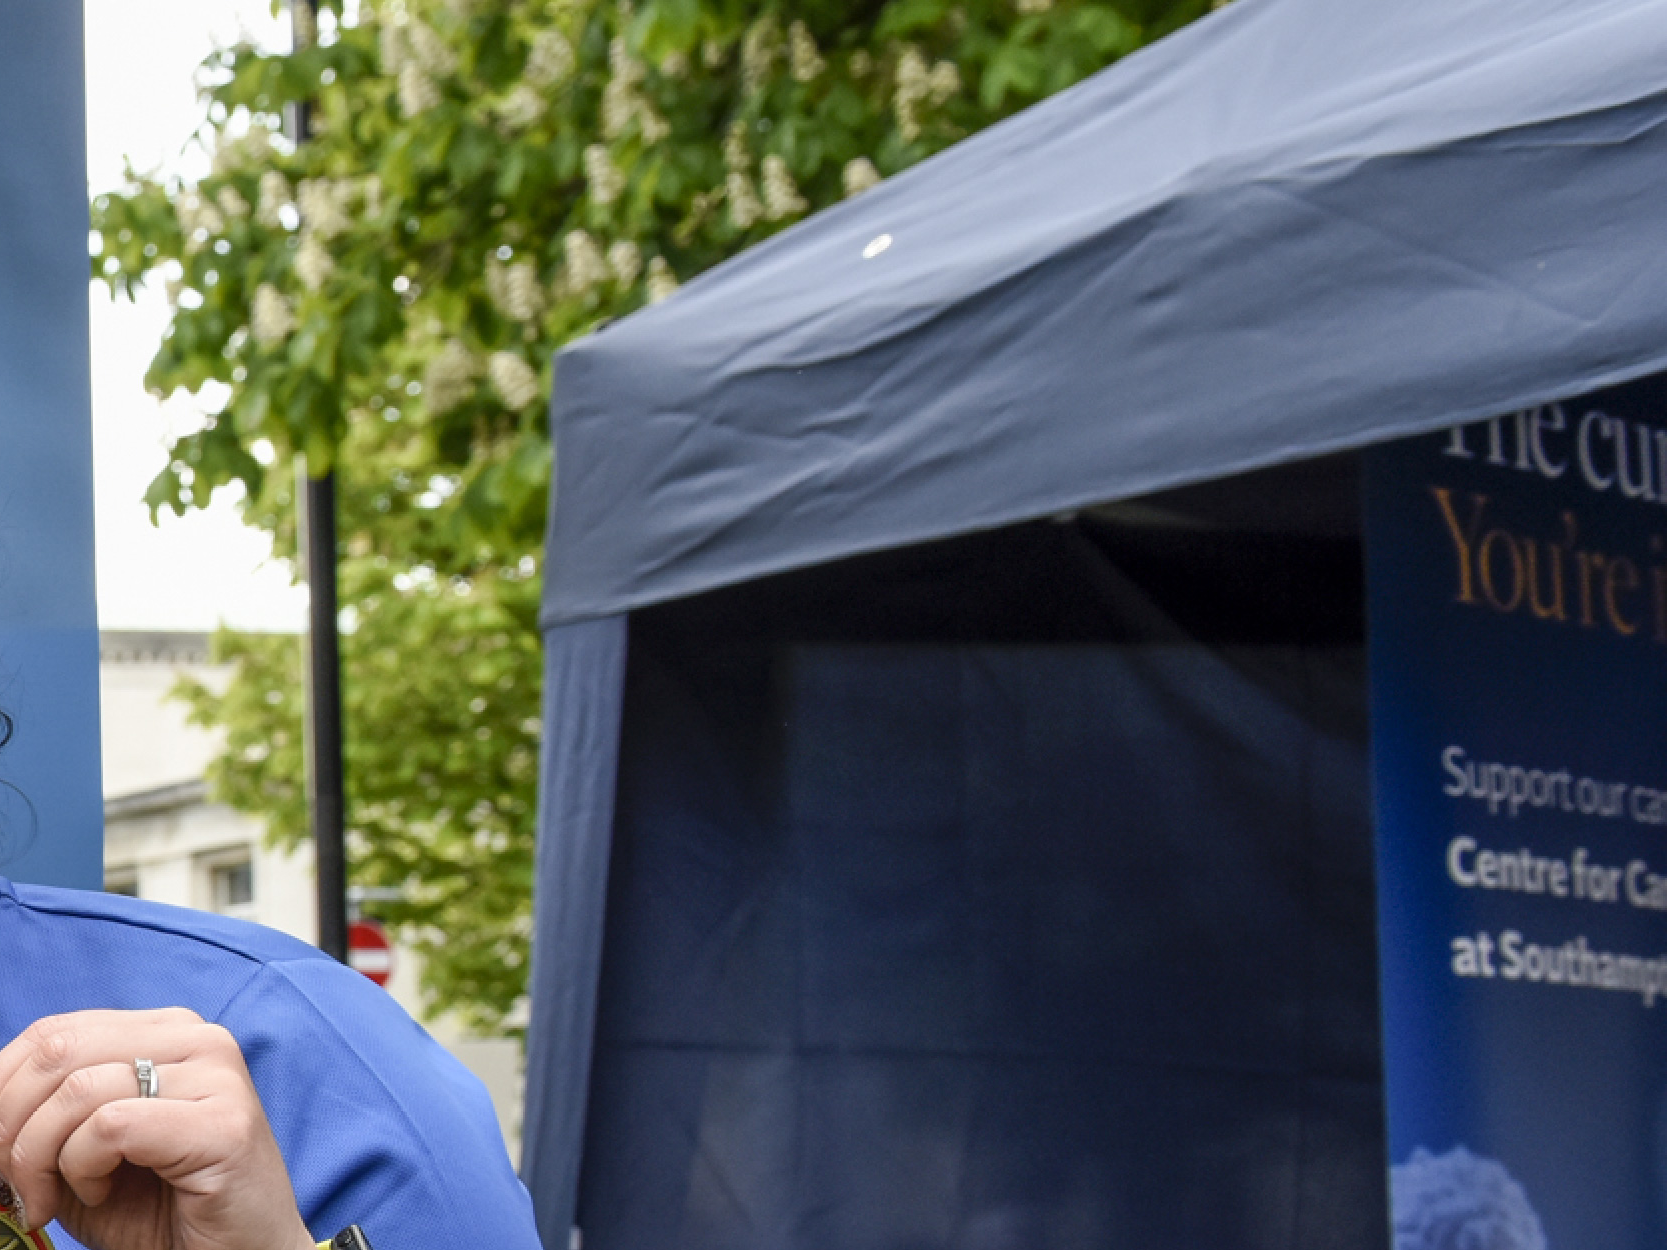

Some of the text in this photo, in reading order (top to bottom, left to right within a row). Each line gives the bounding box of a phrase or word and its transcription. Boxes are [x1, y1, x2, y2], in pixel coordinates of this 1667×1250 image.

[1441, 745, 1575, 817] Support
[1576, 777, 1628, 817] our
[1446, 834, 1569, 898] Centre
[1572, 847, 1622, 903] for
[1449, 931, 1497, 979] at
